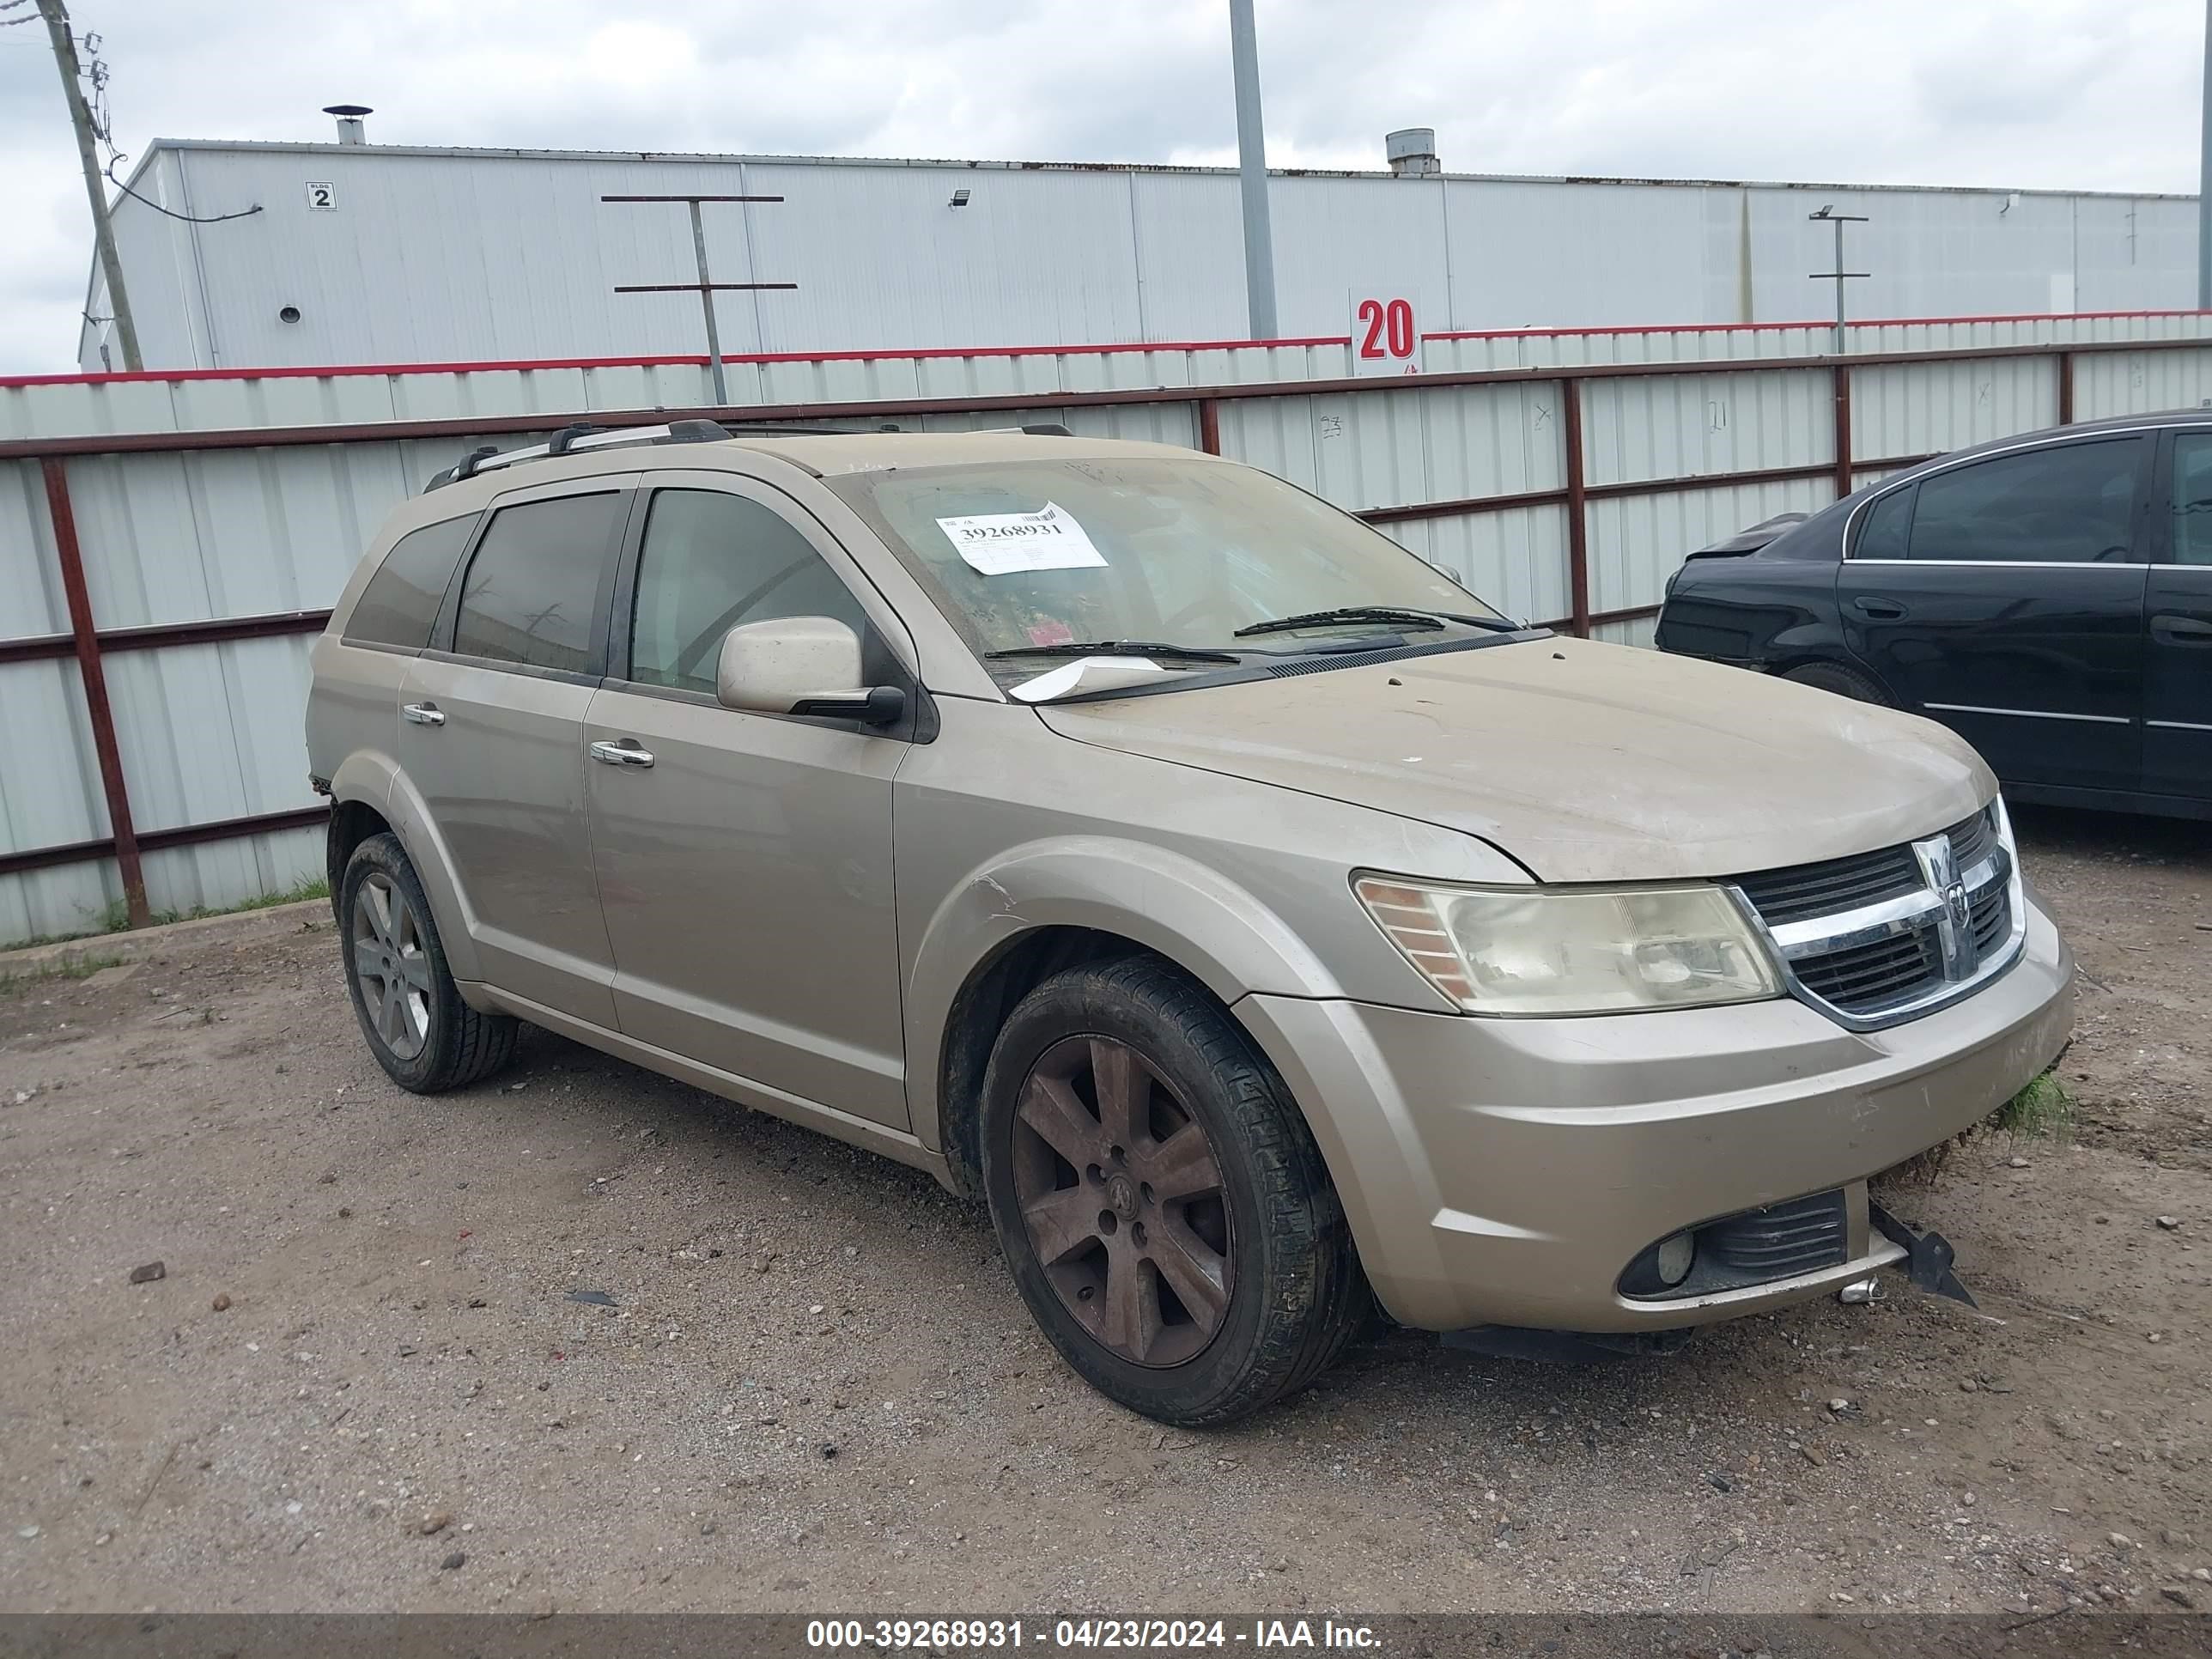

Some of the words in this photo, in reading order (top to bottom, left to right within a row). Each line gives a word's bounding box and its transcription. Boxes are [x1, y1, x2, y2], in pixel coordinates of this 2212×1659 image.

[314, 189, 331, 207] 2
[1358, 298, 1415, 360] 20
[960, 524, 1064, 540] 39268931
